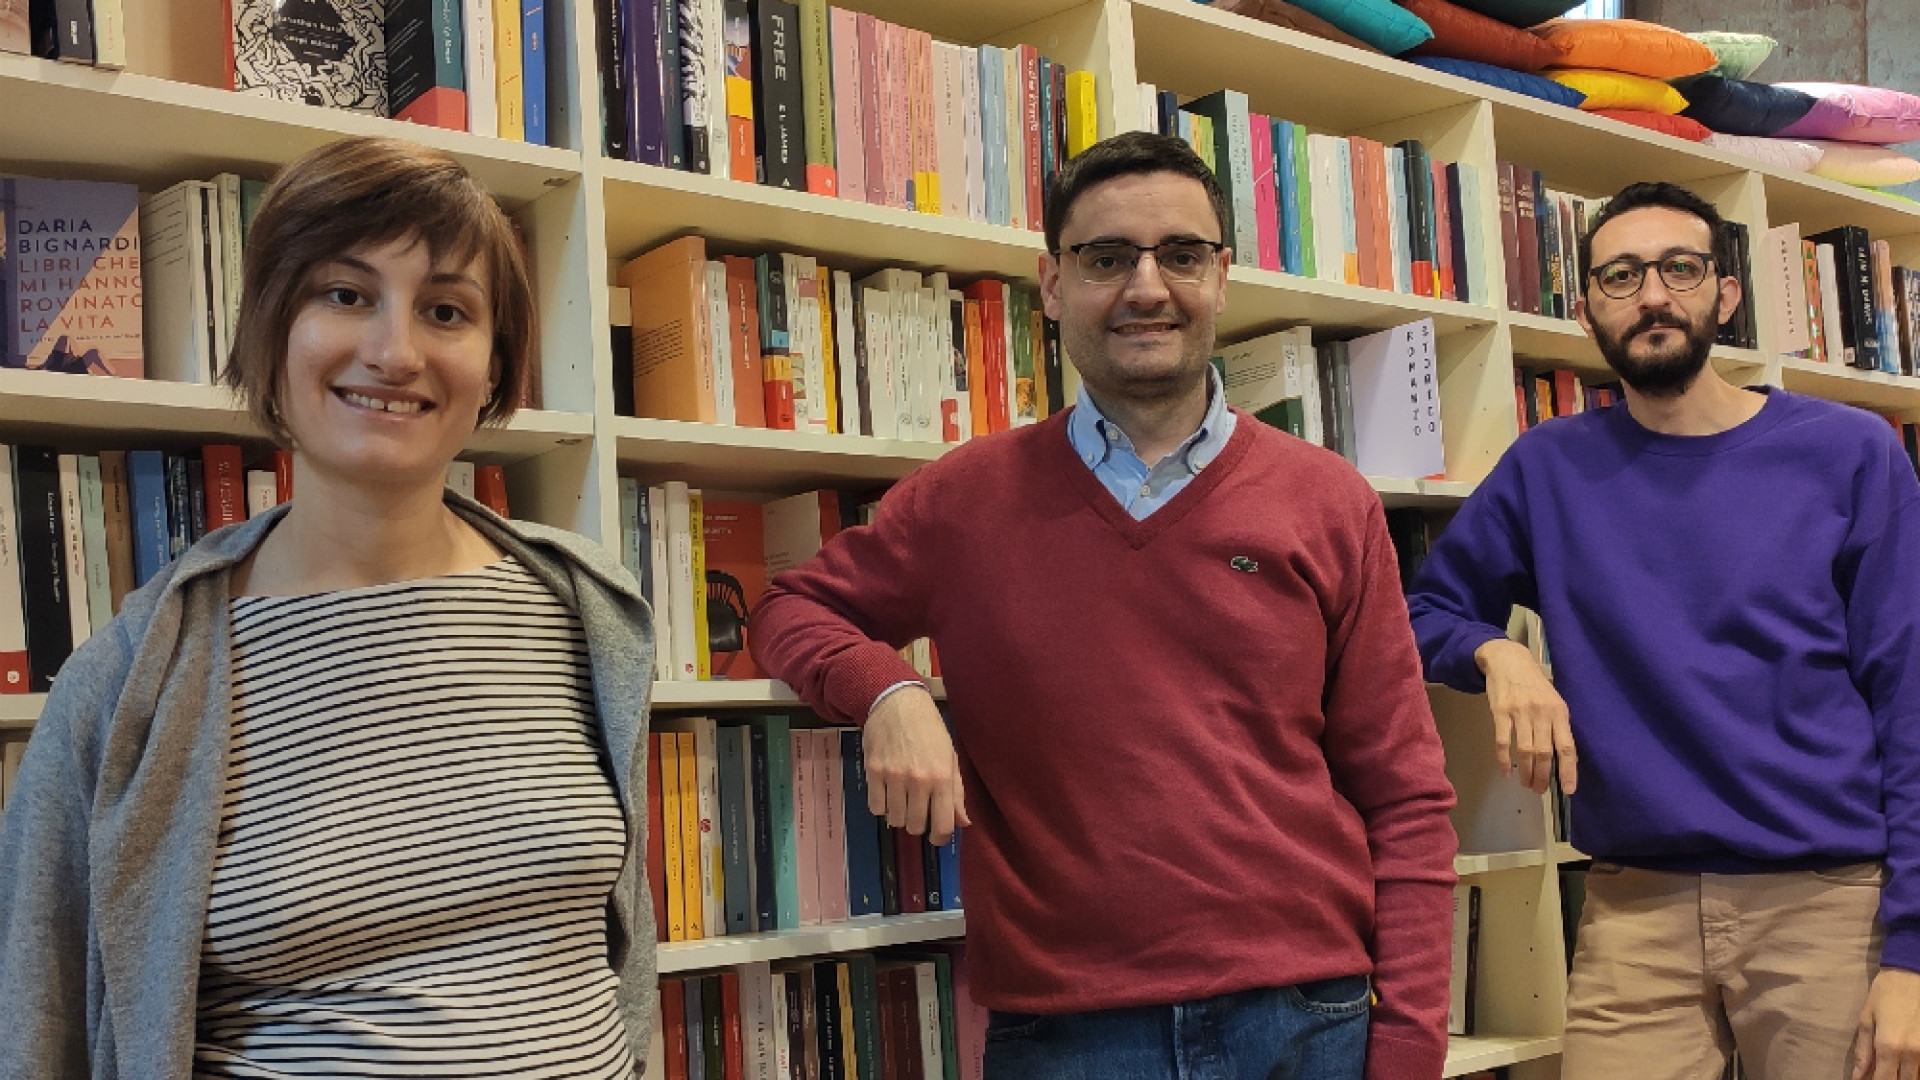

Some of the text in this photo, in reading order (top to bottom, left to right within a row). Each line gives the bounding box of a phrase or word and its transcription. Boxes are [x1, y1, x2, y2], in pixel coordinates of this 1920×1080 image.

[771, 14, 787, 82] FREE
[780, 123, 788, 164] JAMES
[18, 218, 93, 235] DARIA
[18, 237, 138, 253] BIGNARDI
[19, 256, 140, 273] LIBRI CHE
[20, 275, 142, 292] MI HANNO
[1778, 231, 1795, 335] ANTASCIENZA
[20, 293, 143, 313] ROVINATO
[20, 314, 115, 333] LA VITA
[1406, 330, 1422, 436] ROMANZO
[1421, 325, 1436, 433] STORICO
